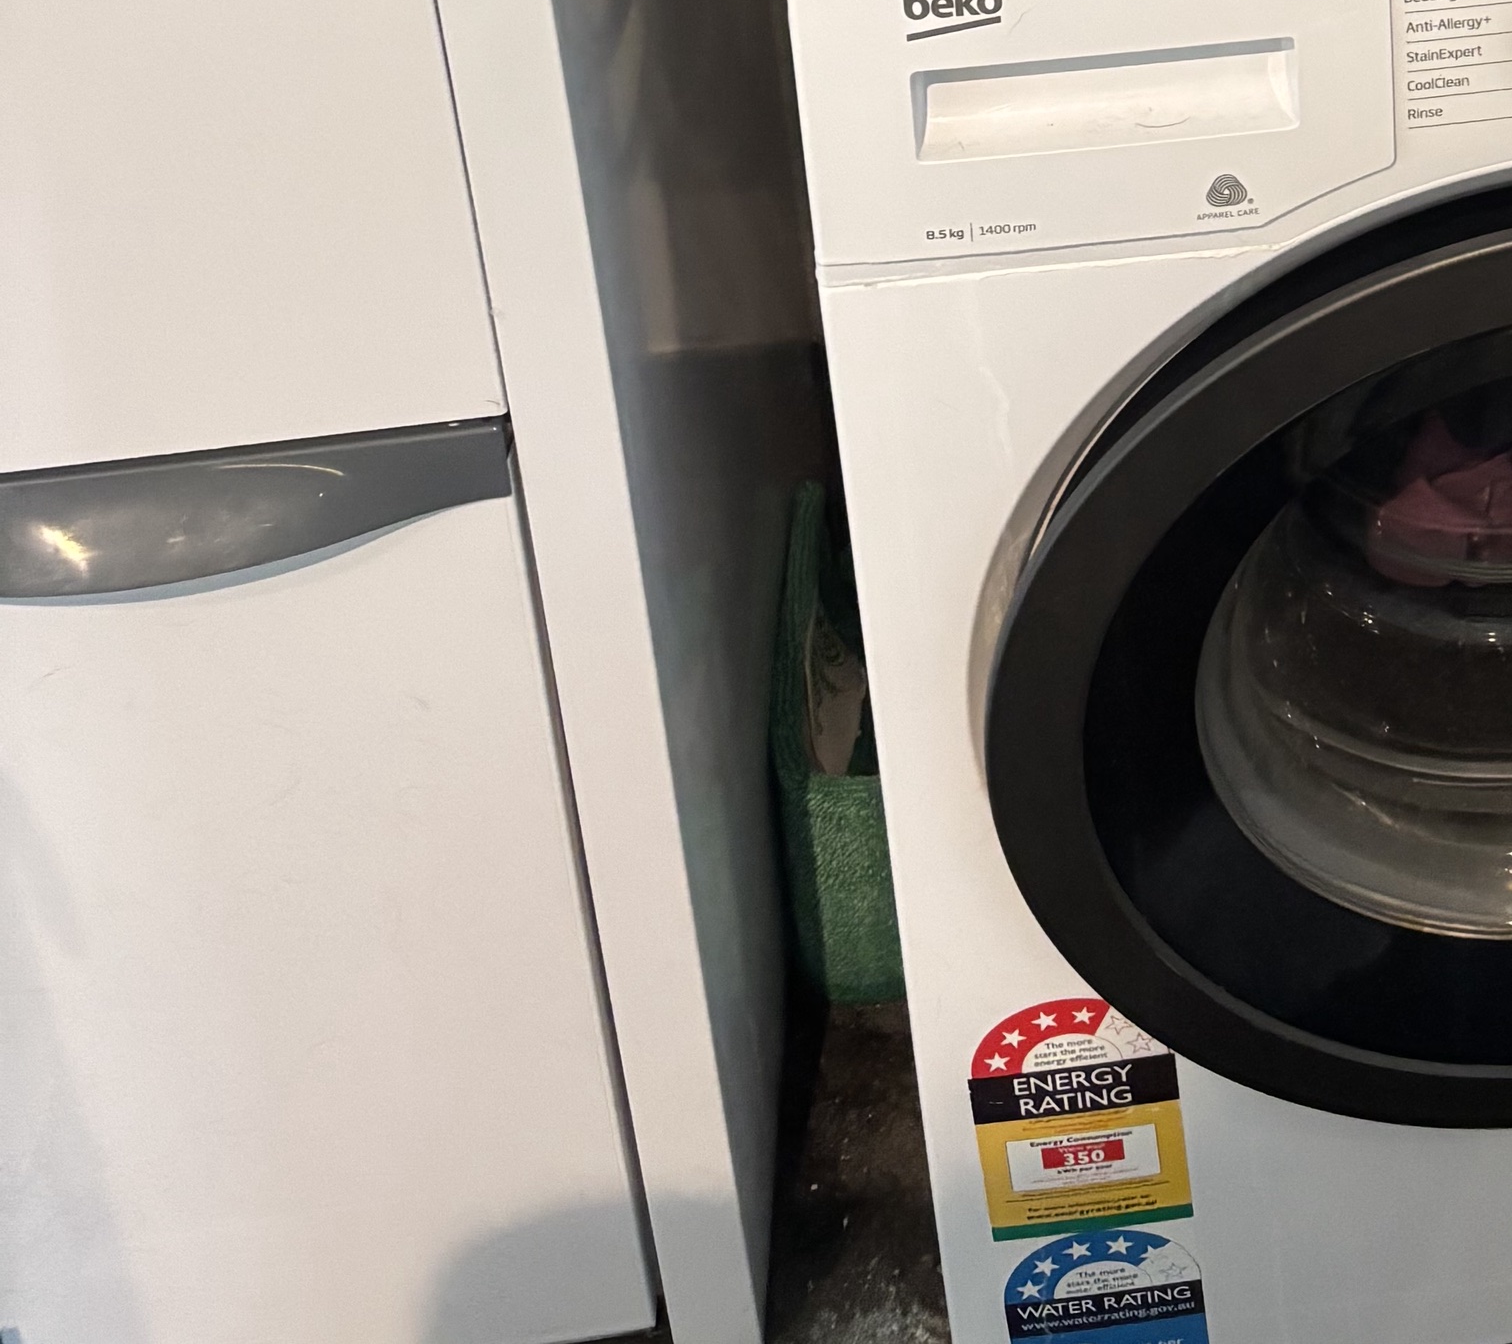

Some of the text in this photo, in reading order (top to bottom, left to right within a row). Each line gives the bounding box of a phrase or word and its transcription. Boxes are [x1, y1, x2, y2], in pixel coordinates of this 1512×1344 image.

[1406, 16, 1492, 33] Anti-Allergy+
[1407, 45, 1483, 63] StainExpert
[1407, 76, 1470, 91] CoolClean
[1407, 107, 1443, 120] Rinse
[1237, 208, 1260, 217] CARE
[926, 228, 964, 240] 8.5 kg
[979, 223, 1036, 236] 1400 rpm
[1044, 1038, 1093, 1050] The more
[1060, 1048, 1077, 1056] the
[1079, 1045, 1105, 1054] more
[1033, 1052, 1108, 1068] energy efficient
[1012, 1063, 1132, 1096] ENERGY
[1018, 1085, 1133, 1116] RATING
[1030, 1139, 1064, 1148] Energy
[1063, 1149, 1105, 1166] 350
[1017, 1286, 1192, 1320] WATER RATING
